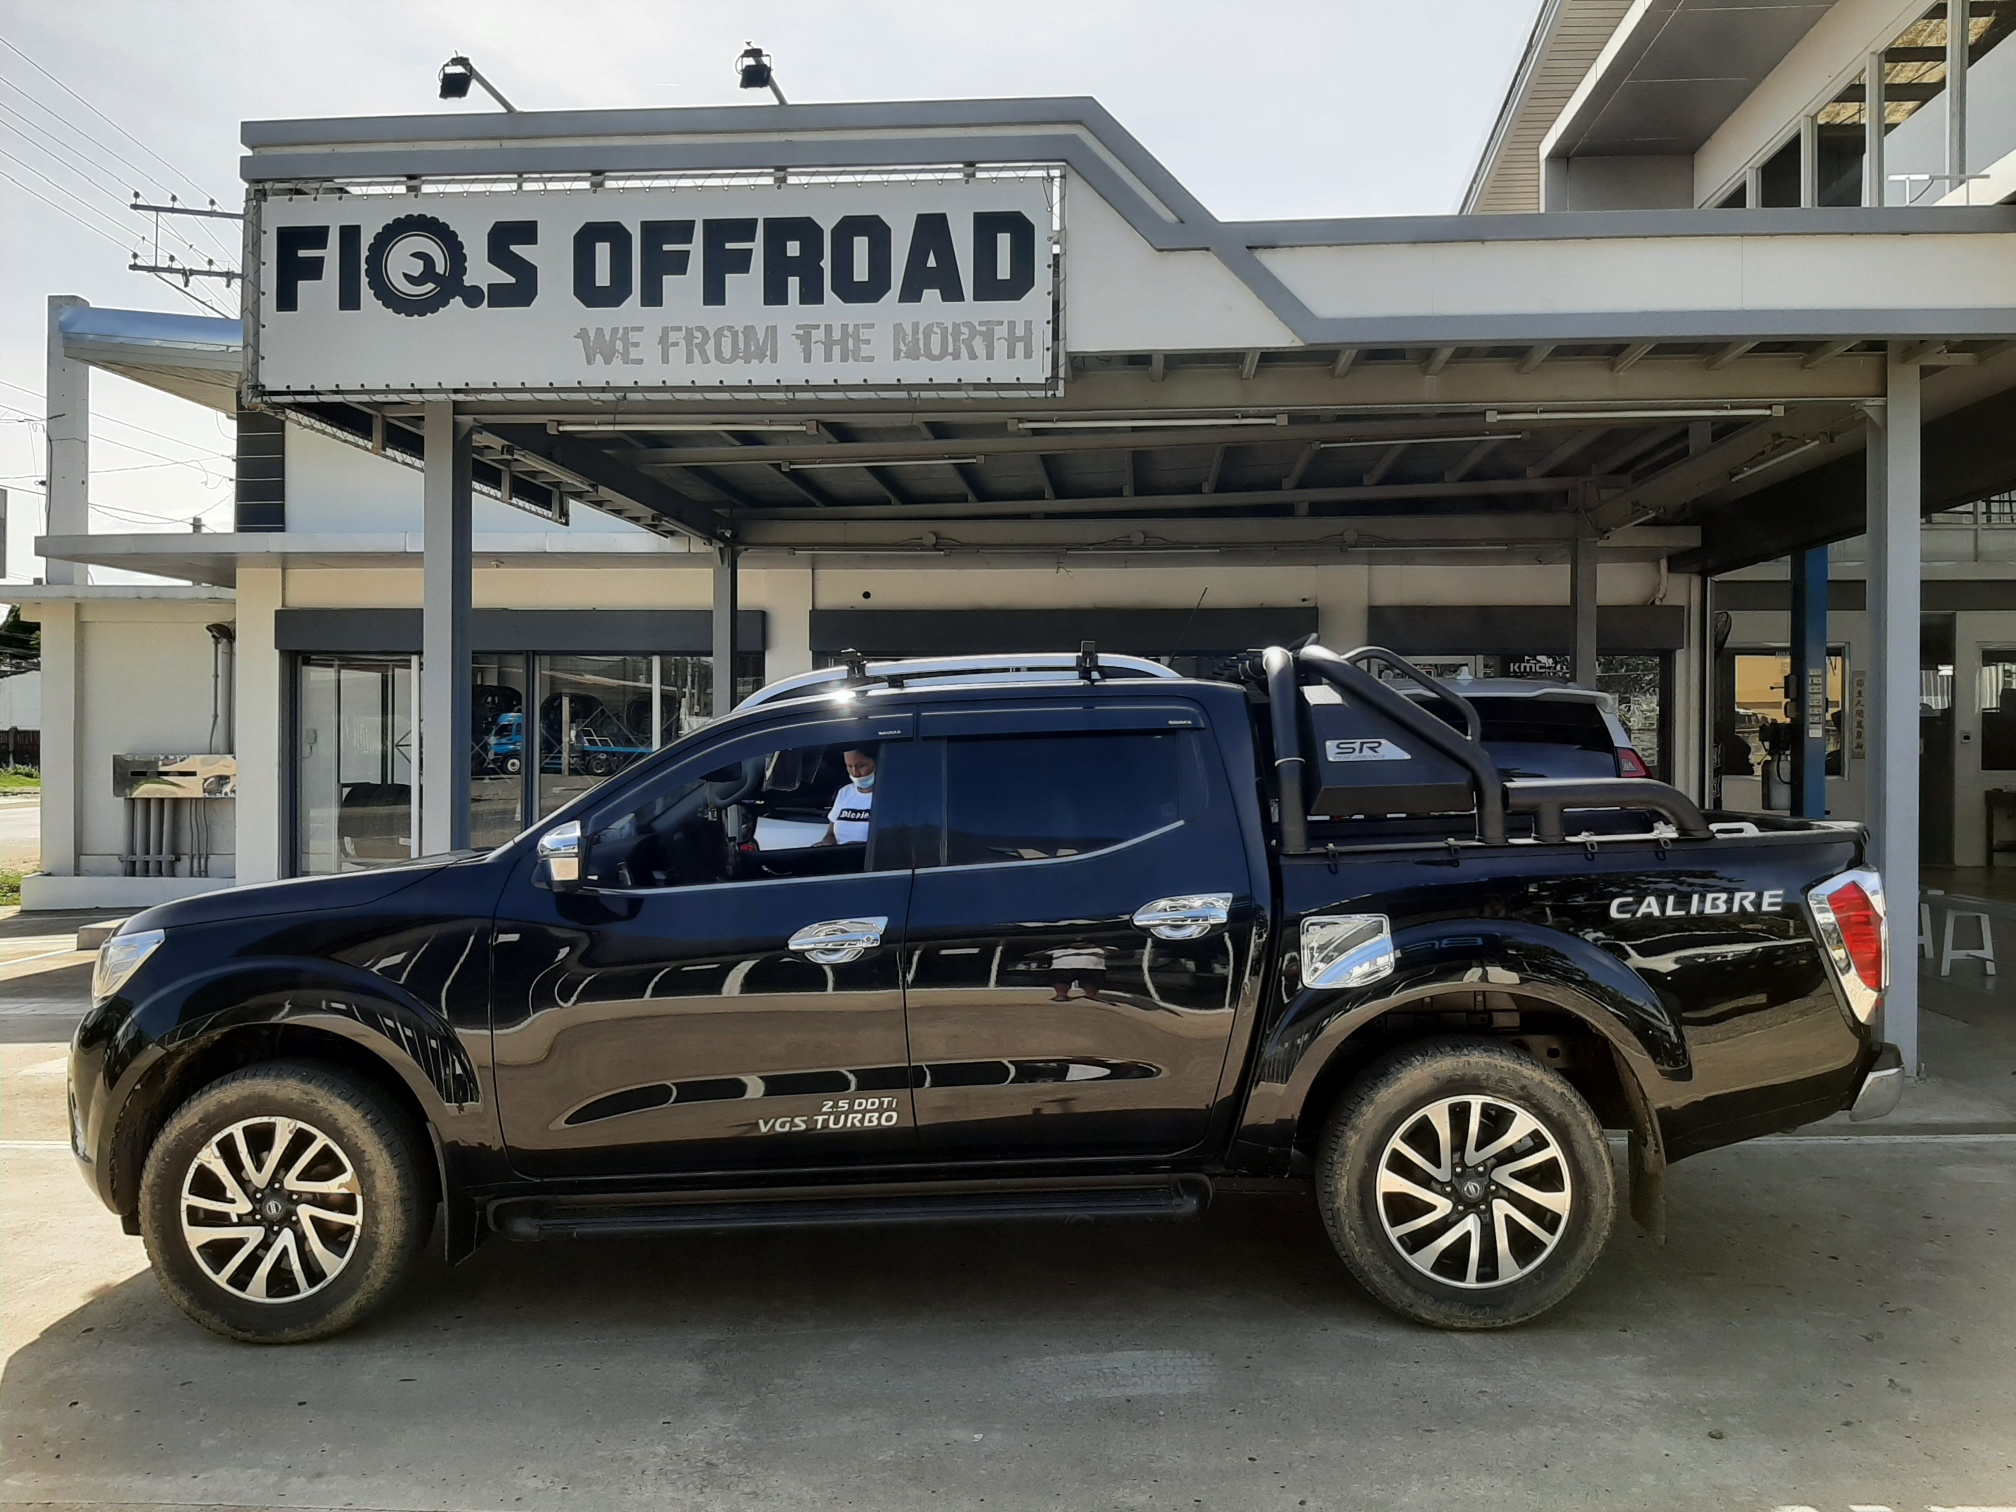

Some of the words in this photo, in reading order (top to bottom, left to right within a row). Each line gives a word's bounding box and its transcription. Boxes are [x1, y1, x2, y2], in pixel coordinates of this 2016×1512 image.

[573, 211, 1036, 309] OFFROAD
[573, 325, 646, 366] WE
[657, 323, 779, 366] FROM
[794, 322, 876, 364] THE
[893, 319, 1035, 362] NORTH
[1334, 740, 1382, 755] SR
[1609, 889, 1784, 919] CALIBRE
[821, 1099, 850, 1112] 2.5
[758, 1116, 808, 1133] VGS
[813, 1111, 898, 1130] TURBO
